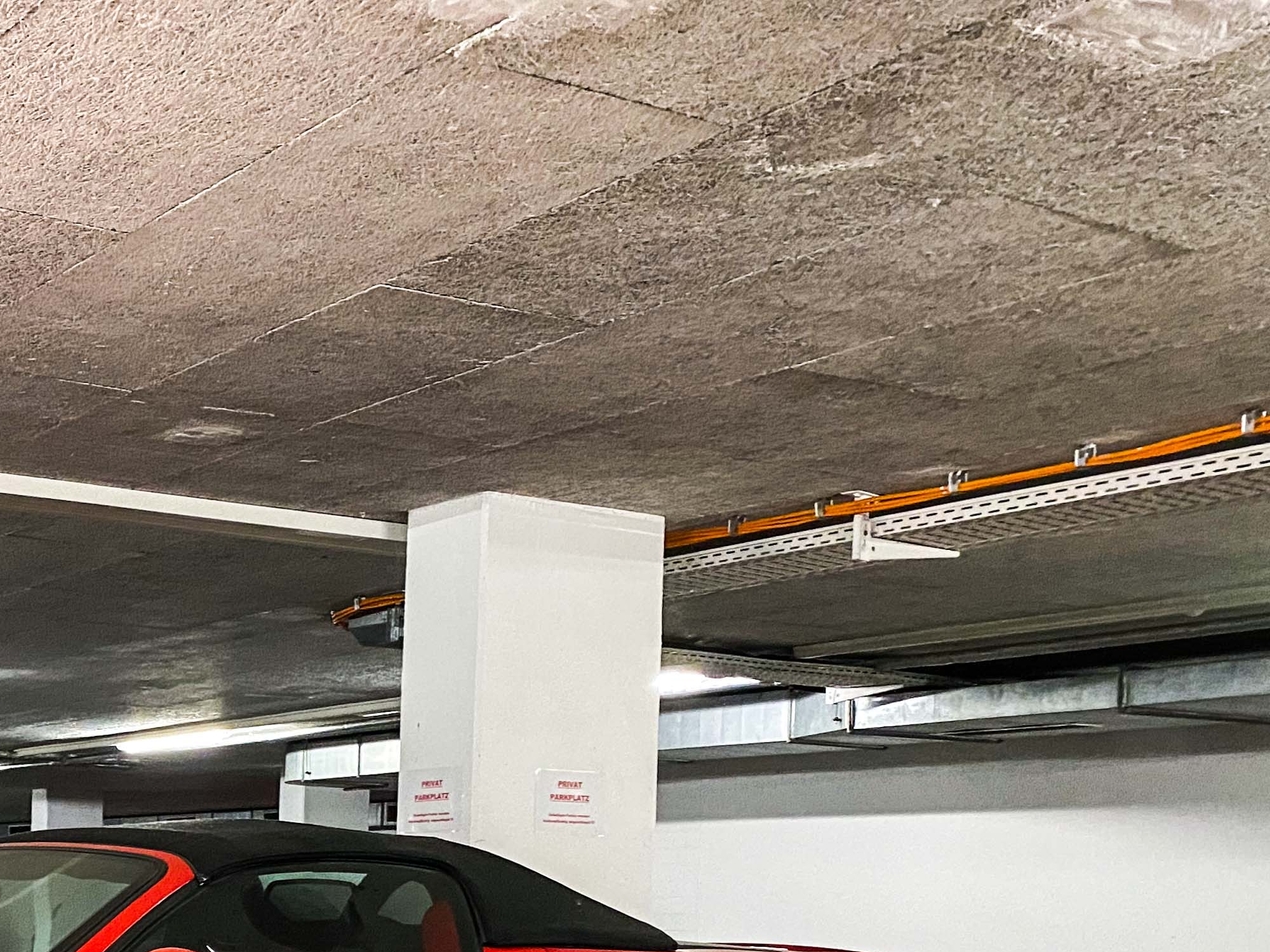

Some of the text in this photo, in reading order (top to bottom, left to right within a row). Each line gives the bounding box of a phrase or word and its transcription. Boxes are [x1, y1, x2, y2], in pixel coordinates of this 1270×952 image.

[421, 780, 443, 788] PRIVAT
[558, 781, 583, 789] PRIVAT
[414, 792, 450, 802] PARKPLATZ
[550, 793, 590, 802] PARKPLATZ
